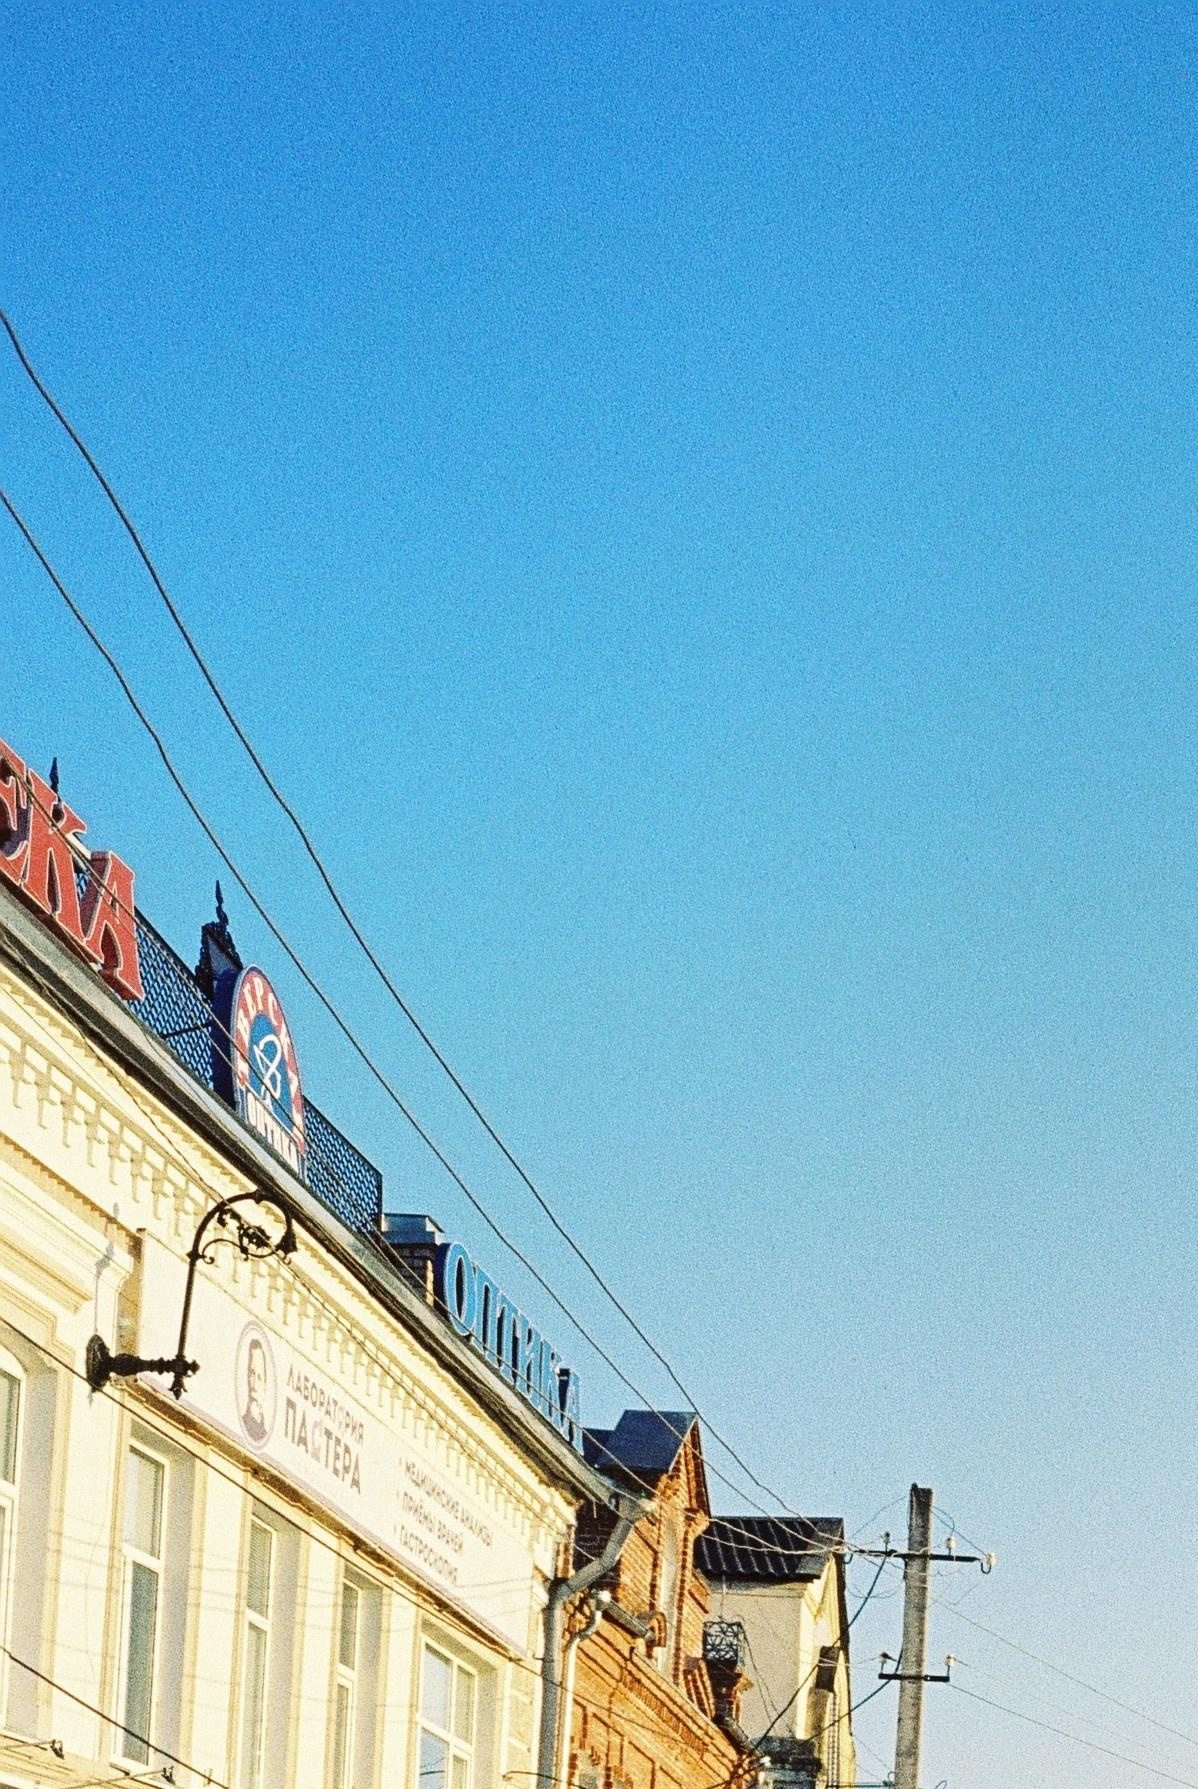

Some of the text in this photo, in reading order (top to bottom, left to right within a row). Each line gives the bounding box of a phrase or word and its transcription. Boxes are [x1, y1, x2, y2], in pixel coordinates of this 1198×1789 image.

[443, 1241, 585, 1456] ОПТИКА
[284, 1396, 361, 1496] ПАСТЕРА
[286, 1363, 365, 1447] ЛАБОРАТОРИЯ
